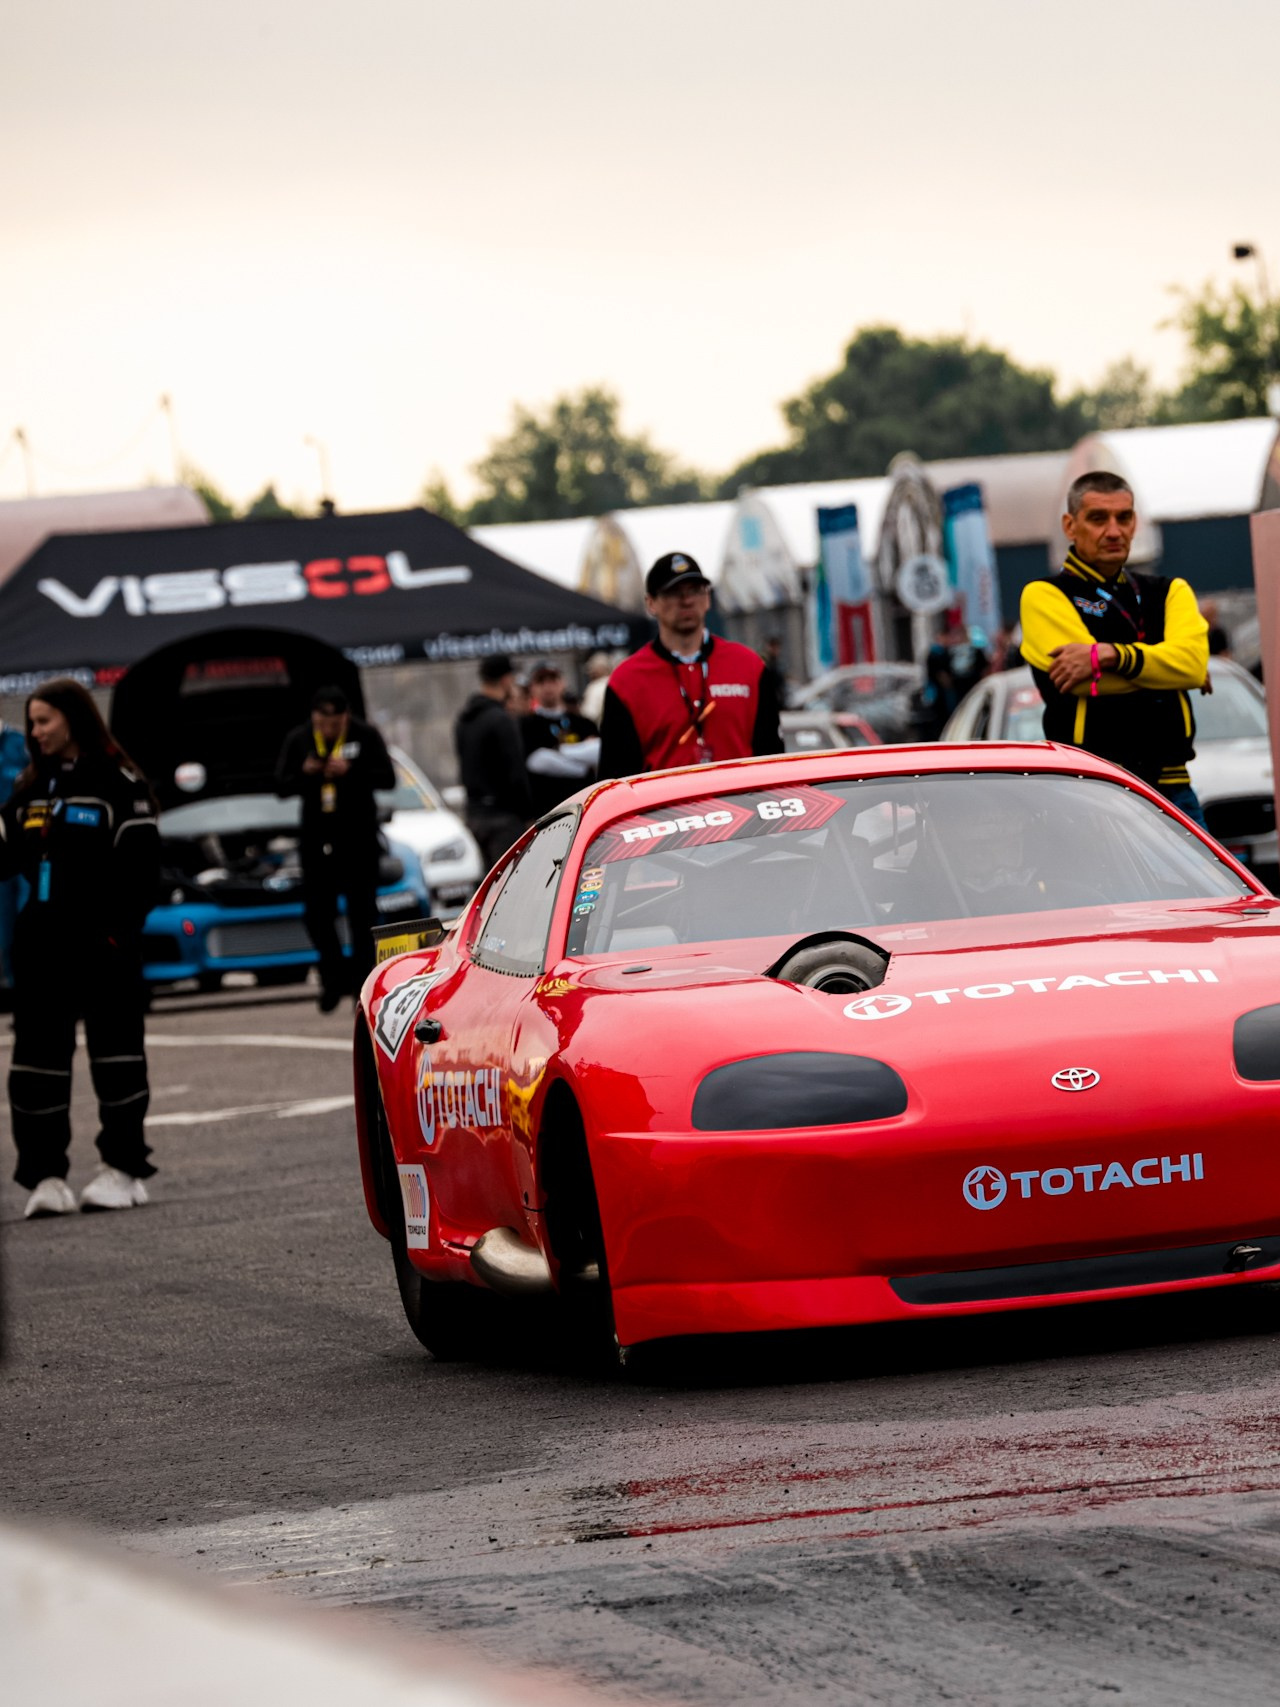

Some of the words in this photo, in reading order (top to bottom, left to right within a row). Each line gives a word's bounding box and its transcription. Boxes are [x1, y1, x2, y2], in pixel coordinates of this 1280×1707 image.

[37, 550, 472, 618] VISSOL
[709, 683, 750, 699] RDRC
[620, 809, 734, 845] RDRC
[756, 798, 807, 822] 63
[913, 968, 1221, 1005] TOTACHI
[432, 1067, 504, 1129] TOTACHI
[1010, 1151, 1205, 1199] TOTACHI
